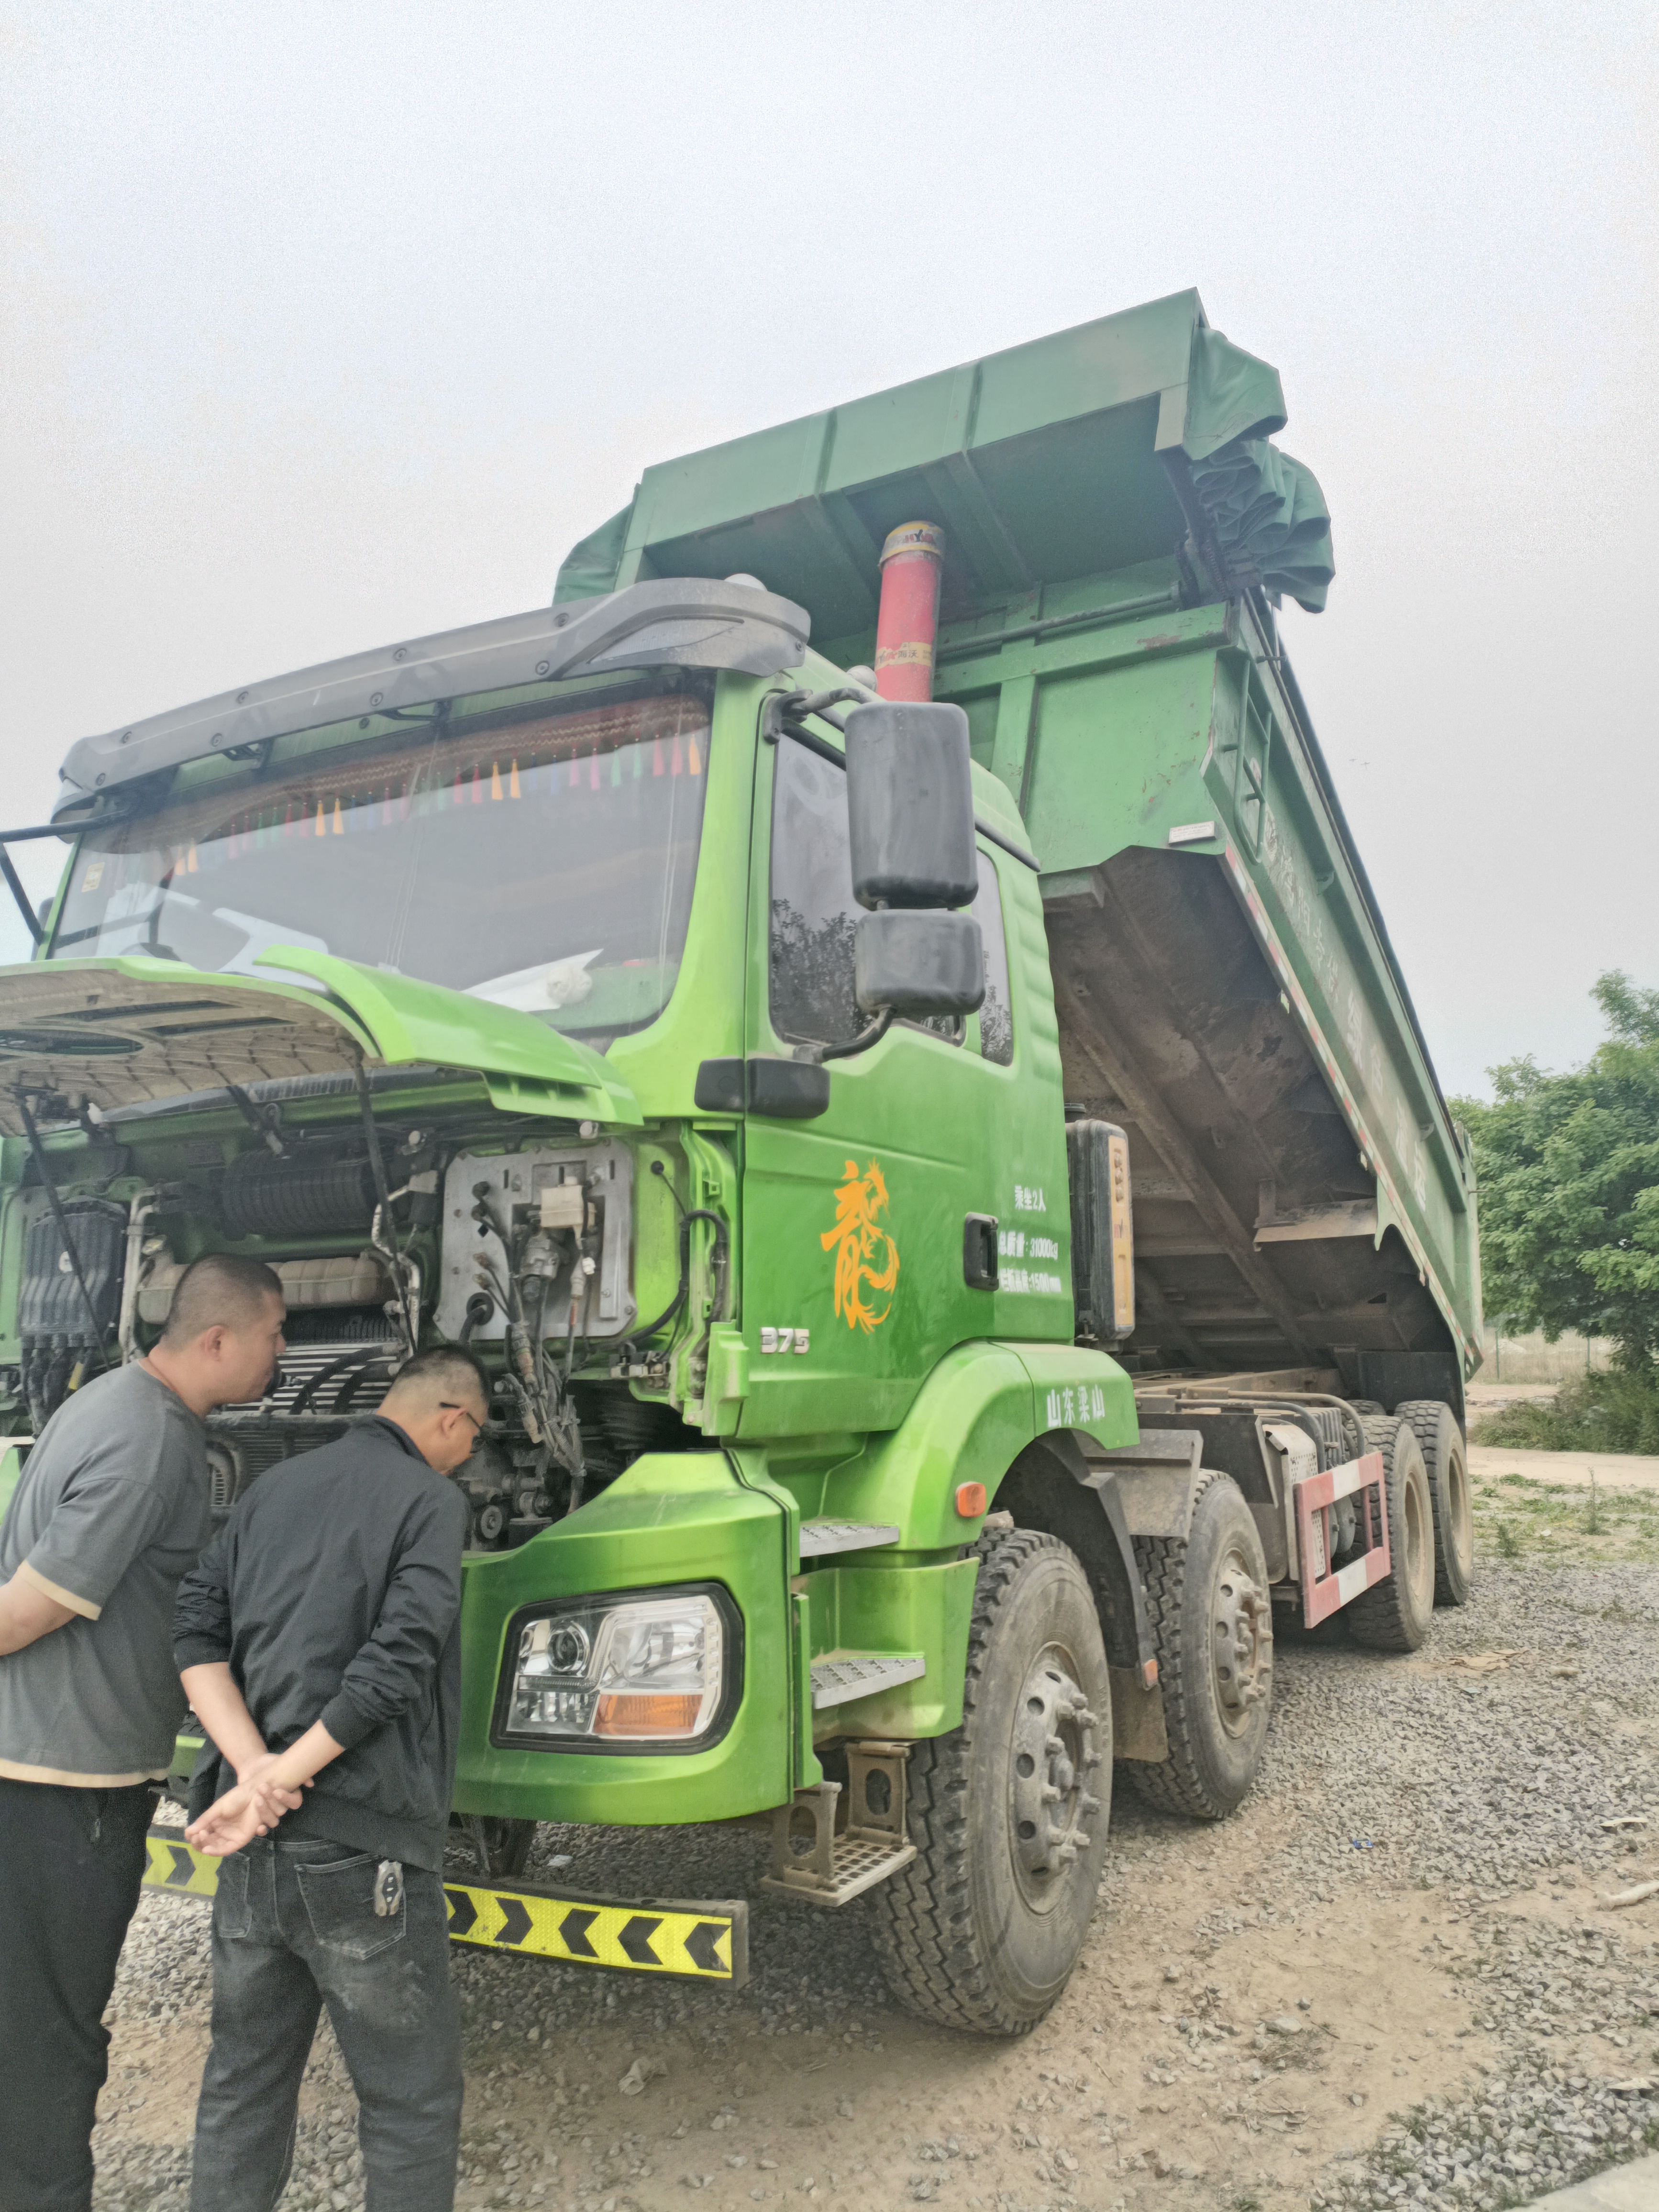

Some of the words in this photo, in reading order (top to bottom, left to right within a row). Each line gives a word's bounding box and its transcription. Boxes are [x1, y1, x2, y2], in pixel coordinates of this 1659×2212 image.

[898, 649, 918, 659] 海沃
[1015, 1185, 1046, 1212] 乘坐2人
[761, 1327, 810, 1354] 375
[1047, 1383, 1106, 1427] 山东梁山
